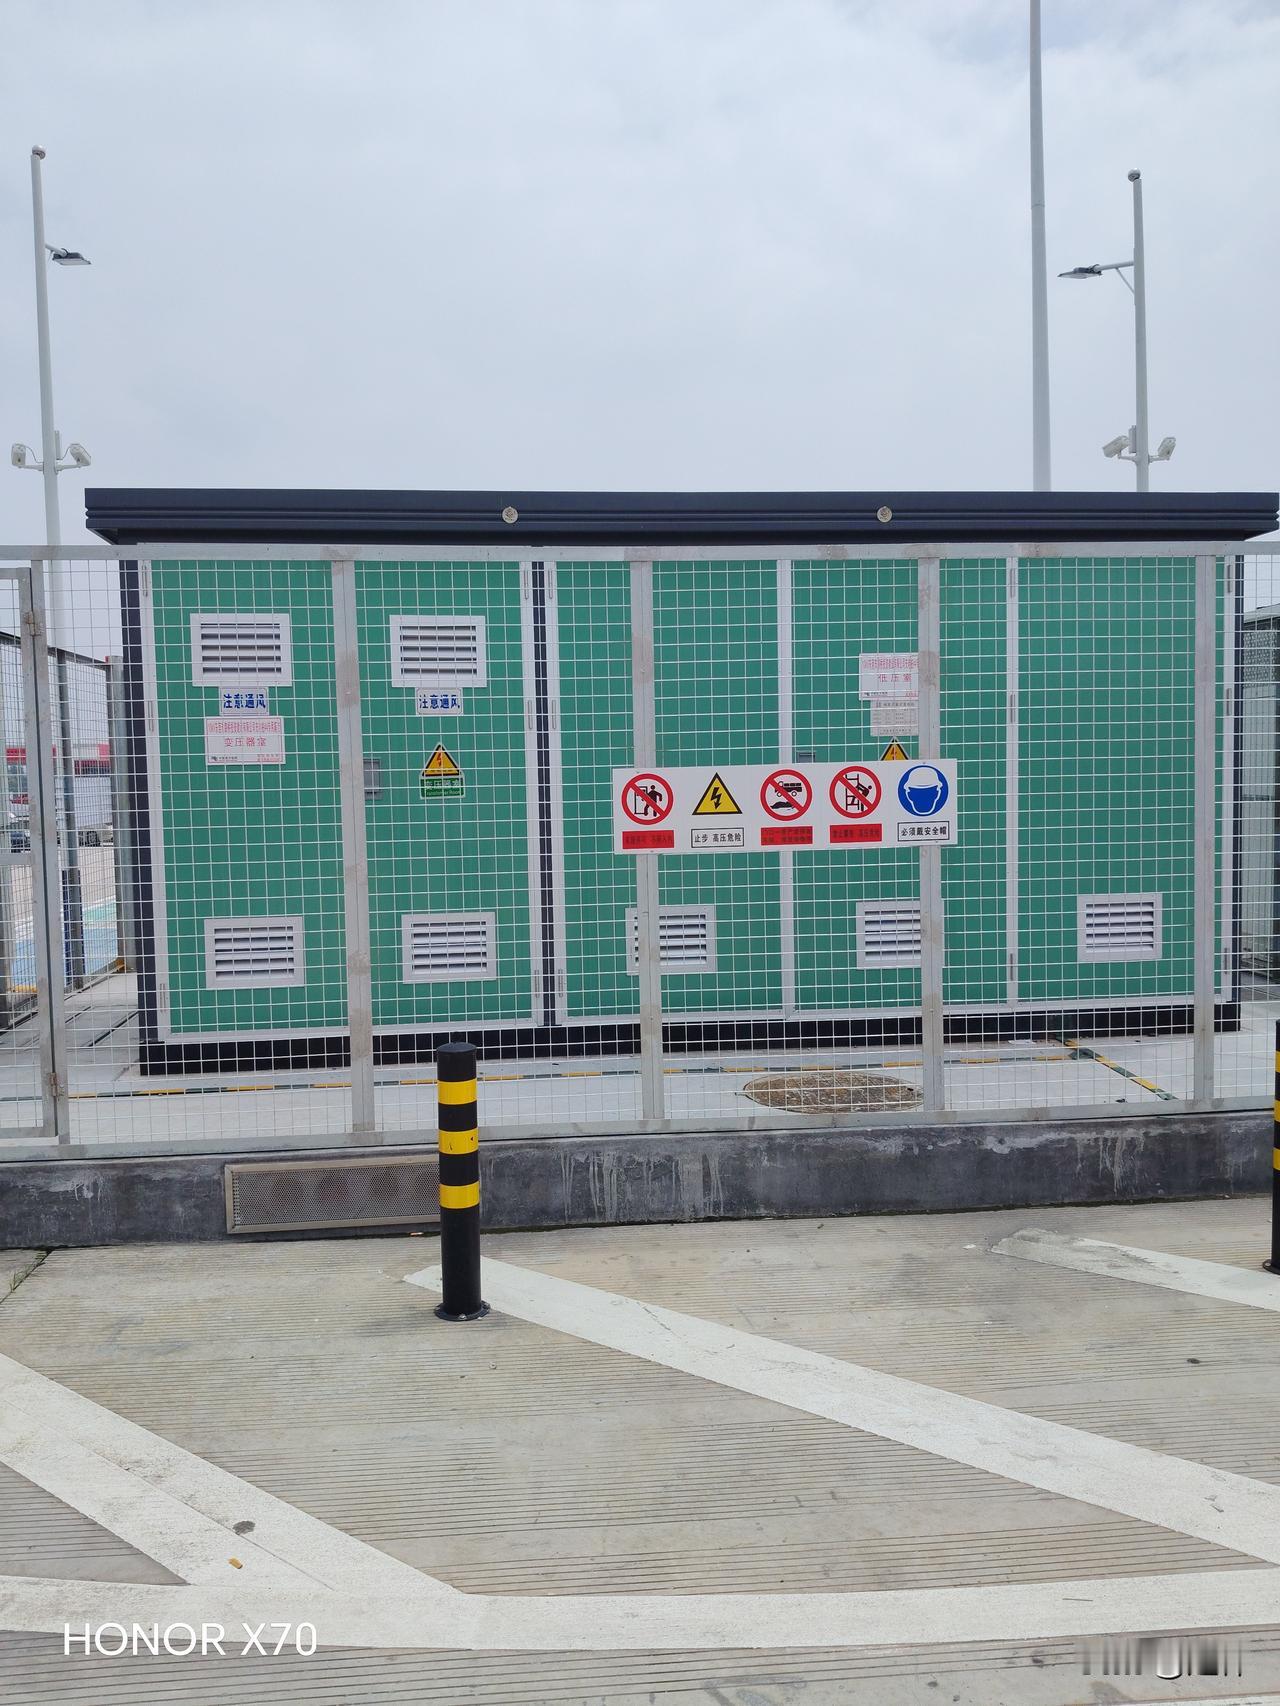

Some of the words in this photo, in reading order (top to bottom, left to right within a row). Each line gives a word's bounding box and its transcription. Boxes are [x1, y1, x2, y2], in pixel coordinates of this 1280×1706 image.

[223, 693, 267, 709] 注意通风
[419, 694, 461, 709] 注意通风
[224, 736, 267, 748] 变压器室
[900, 825, 948, 837] 必须戴安全帽
[694, 833, 709, 843] 止步
[712, 832, 742, 843] 高压危险
